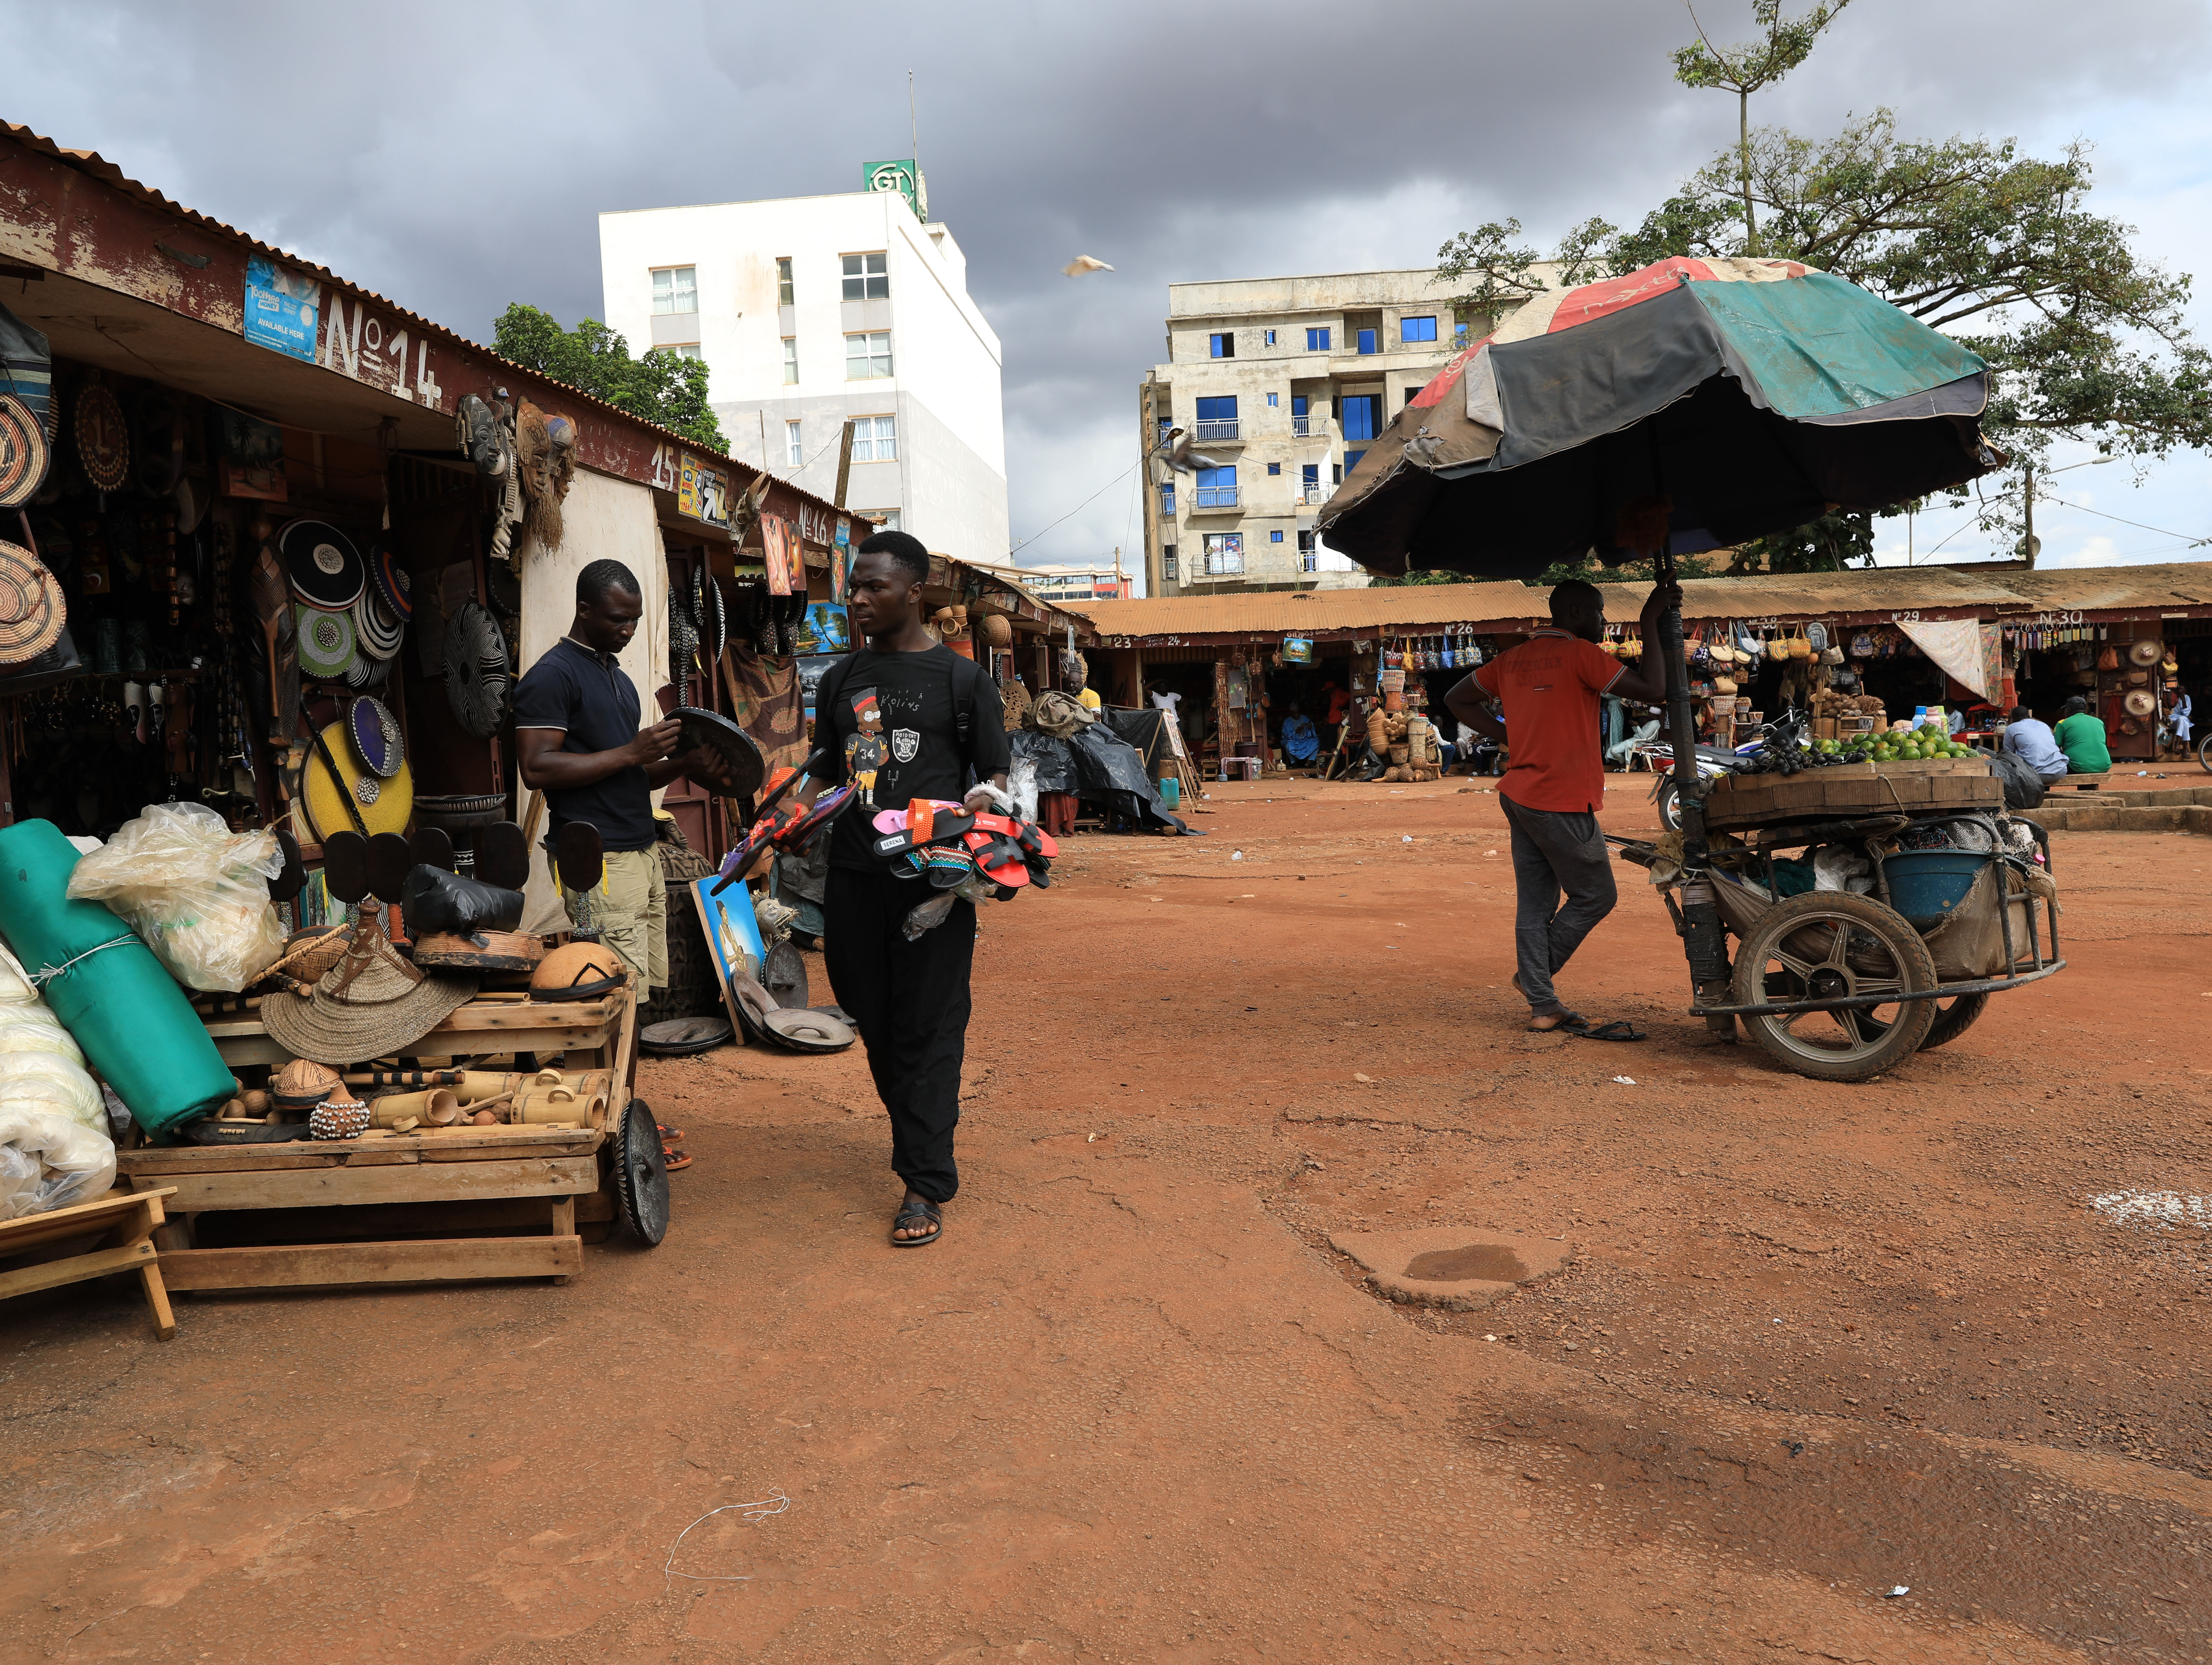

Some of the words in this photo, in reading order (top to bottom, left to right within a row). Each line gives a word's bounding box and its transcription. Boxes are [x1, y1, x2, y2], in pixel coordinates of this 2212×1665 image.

[258, 318, 288, 334] AVAILABLE
[289, 329, 304, 340] HERE
[389, 329, 442, 409] 14
[651, 440, 674, 491] 15
[682, 481, 692, 490] MOBILE
[682, 488, 692, 497] MONEY
[813, 510, 827, 546] 16
[1903, 611, 1920, 622] 29
[2057, 610, 2082, 624] 30
[1458, 623, 1473, 634] 26
[1608, 623, 1622, 635] 27
[1758, 617, 1777, 629] 28
[1114, 636, 1131, 648] 23
[1168, 636, 1180, 646] 24
[860, 748, 875, 760] 34
[883, 838, 903, 848] SERENA
